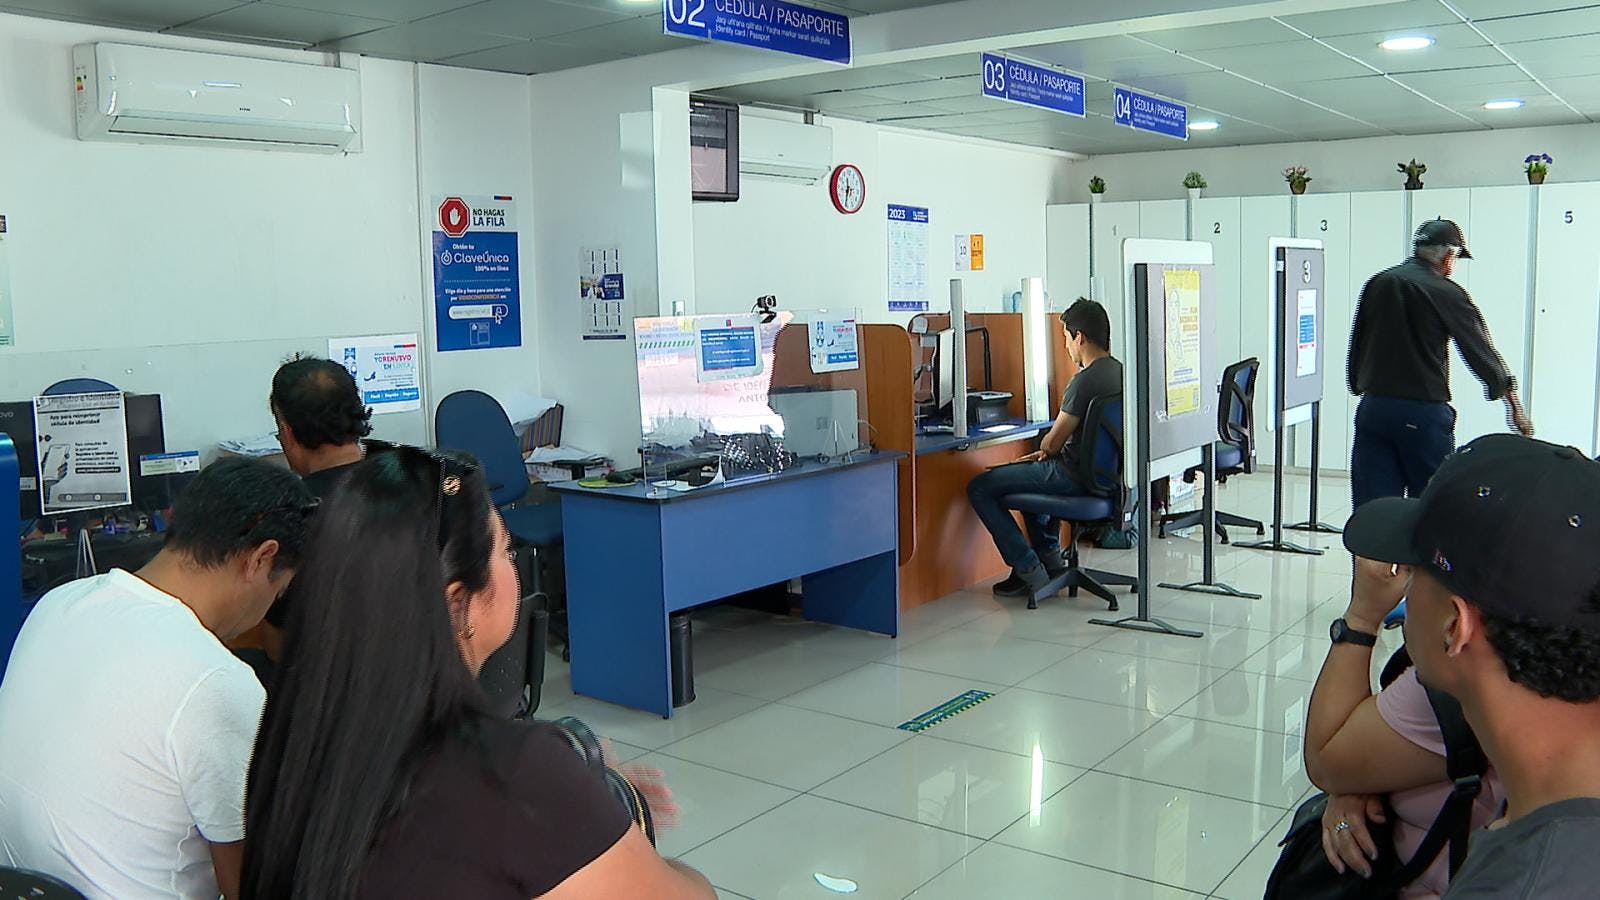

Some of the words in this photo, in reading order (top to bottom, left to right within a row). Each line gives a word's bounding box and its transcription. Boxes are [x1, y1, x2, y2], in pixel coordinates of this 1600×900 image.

[668, 0, 706, 28] 02
[777, 8, 844, 37] PASAPORTE
[984, 60, 1005, 91] 03
[1009, 65, 1038, 87] CÉDULA
[1043, 73, 1081, 96] PASAPORTE
[1116, 95, 1131, 120] 04
[472, 208, 482, 216] NO
[483, 208, 505, 216] HAGAS
[889, 208, 906, 219] 2023
[1564, 211, 1573, 224] 5
[472, 217, 485, 227] LA
[486, 217, 505, 227] FILA
[1214, 222, 1221, 234] 2
[1320, 219, 1328, 231] 3
[1112, 225, 1117, 237] 1
[453, 250, 510, 263] ClaveÚnica
[1302, 260, 1311, 284] 3
